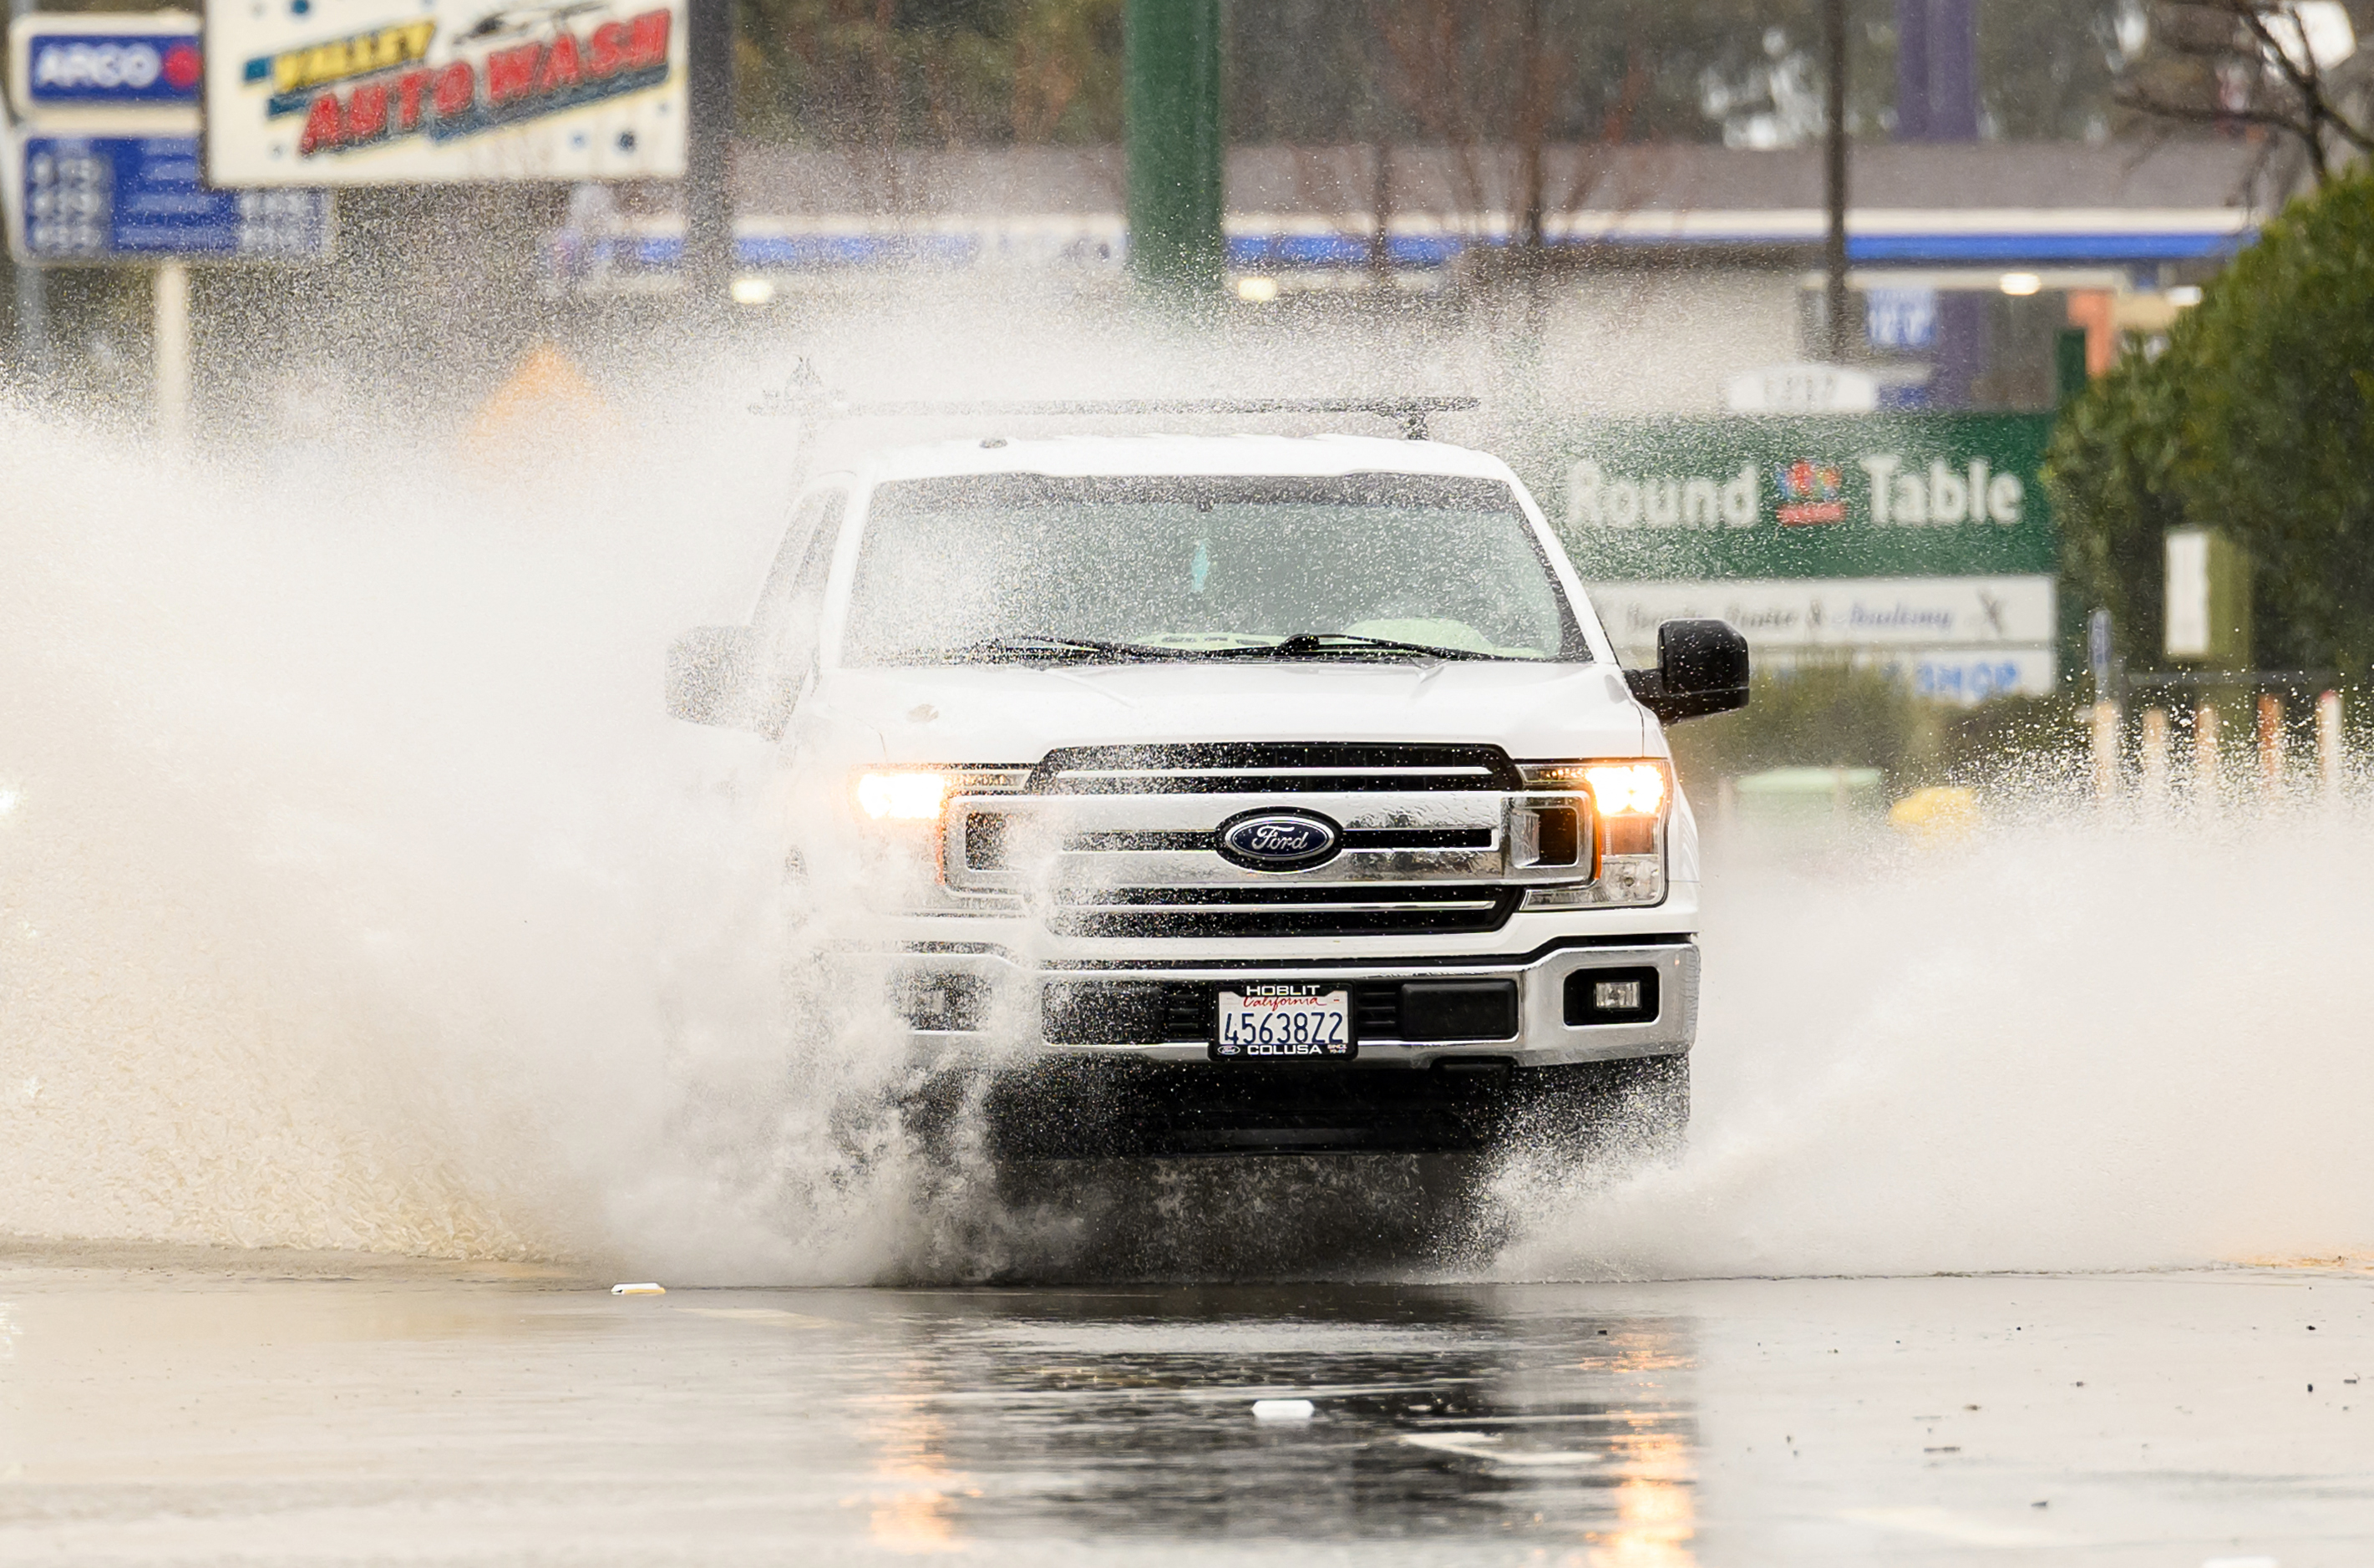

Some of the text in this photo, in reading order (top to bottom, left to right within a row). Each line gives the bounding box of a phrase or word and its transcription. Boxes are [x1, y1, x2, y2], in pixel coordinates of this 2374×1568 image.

[35, 43, 160, 88] ARCO
[298, 8, 671, 157] AUTO WASH
[1567, 454, 2023, 528] Round Table
[1251, 825, 1310, 850] Ford
[1245, 985, 1321, 997] HOBLIT
[1243, 997, 1326, 1012] California
[1246, 1044, 1322, 1056] COLUSA
